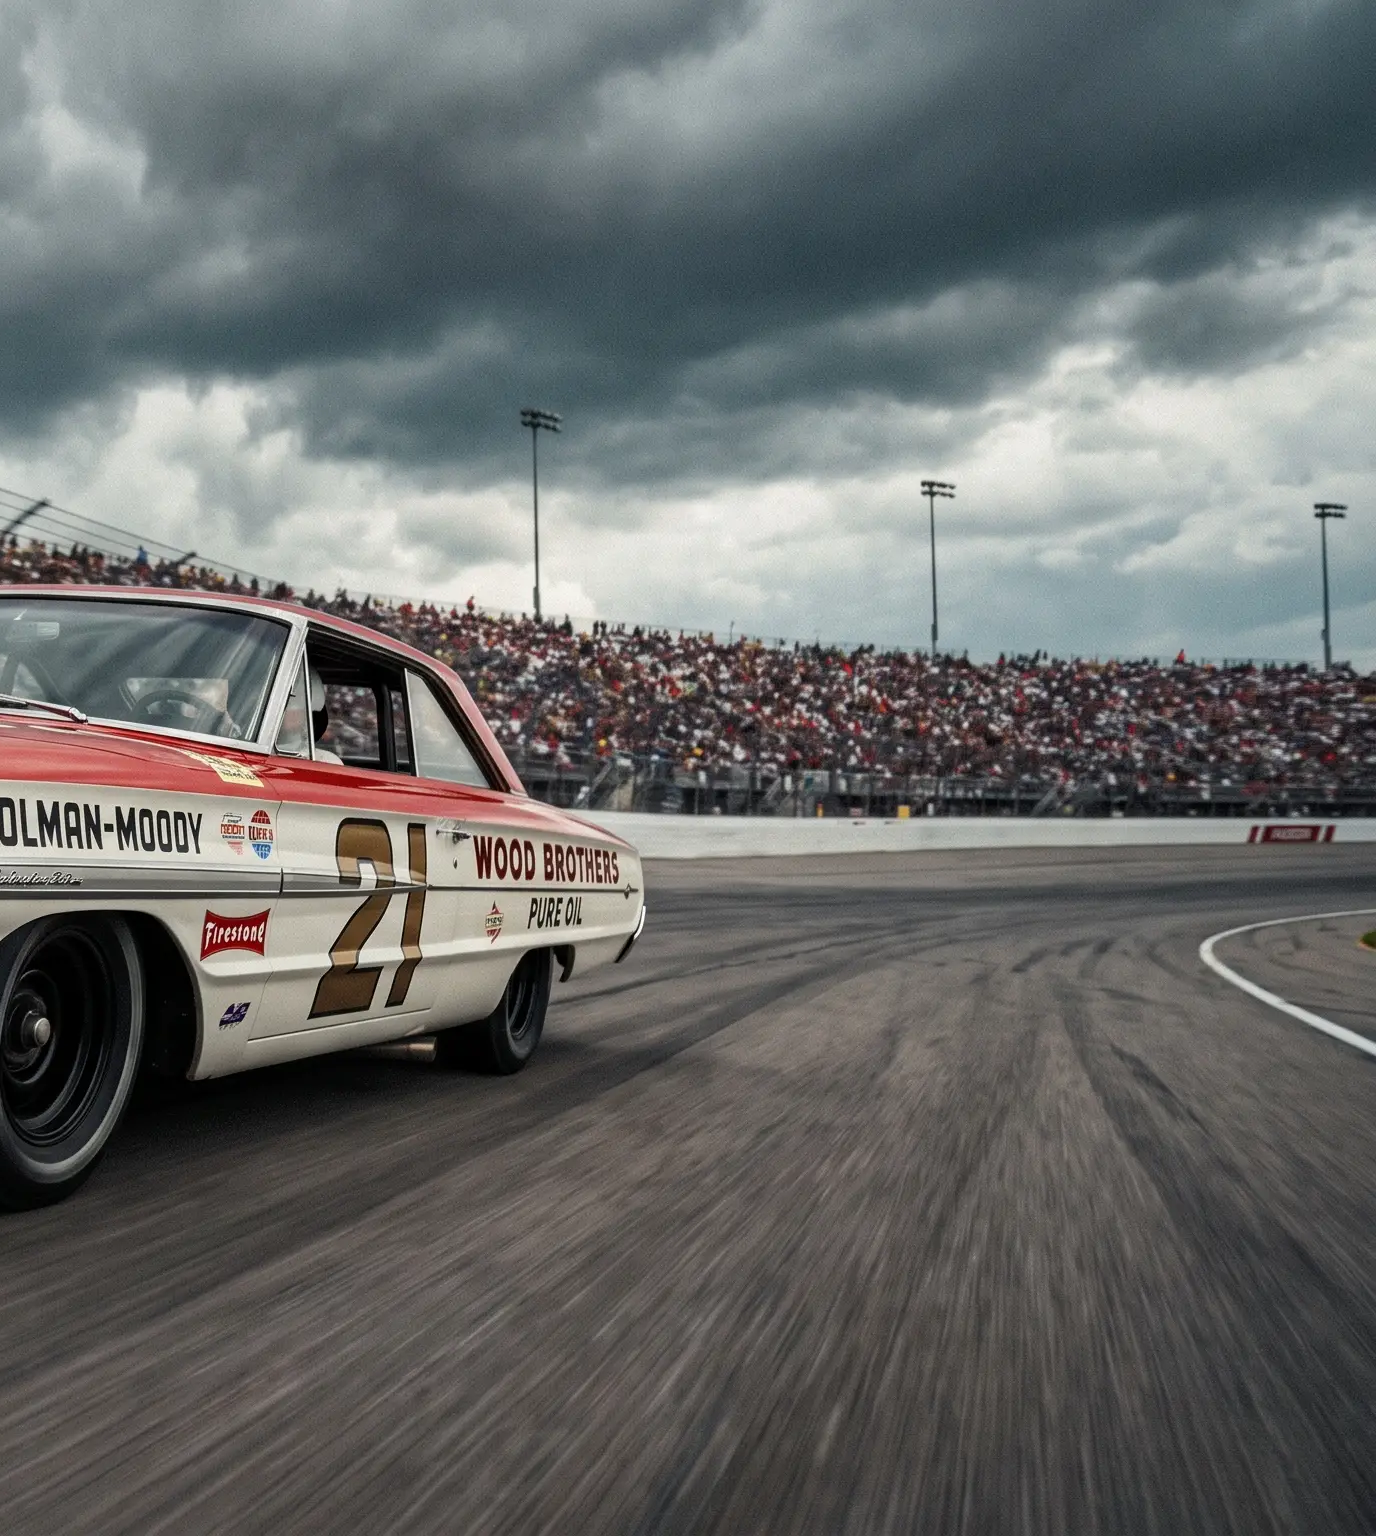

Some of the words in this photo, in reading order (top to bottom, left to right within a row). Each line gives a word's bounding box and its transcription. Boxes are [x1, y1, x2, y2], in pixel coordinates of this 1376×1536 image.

[473, 835, 536, 880] WOOD
[543, 842, 620, 884] BROTHERS
[307, 817, 427, 1020] 21
[527, 897, 564, 929] PURE
[565, 896, 582, 926] OIL
[205, 922, 265, 950] Firestone
